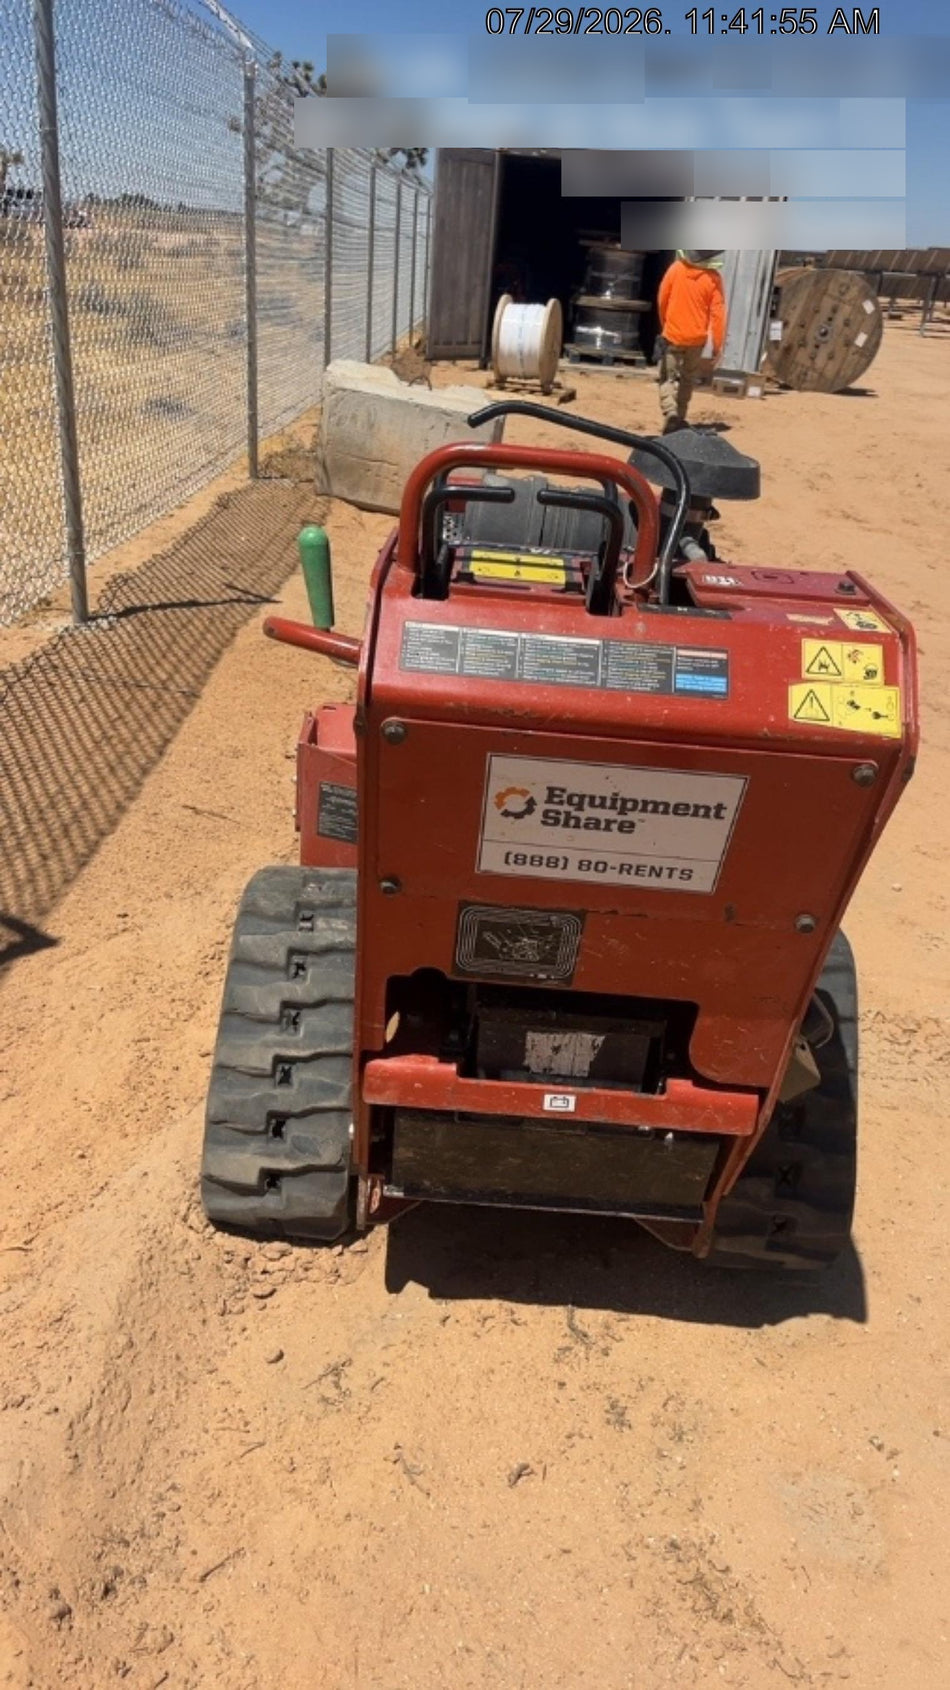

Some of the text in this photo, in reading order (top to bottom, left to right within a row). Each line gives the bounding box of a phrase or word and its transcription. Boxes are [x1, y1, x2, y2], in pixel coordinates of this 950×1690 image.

[544, 786, 727, 820] Equipment
[503, 851, 694, 881] (888) 80-RENTS
